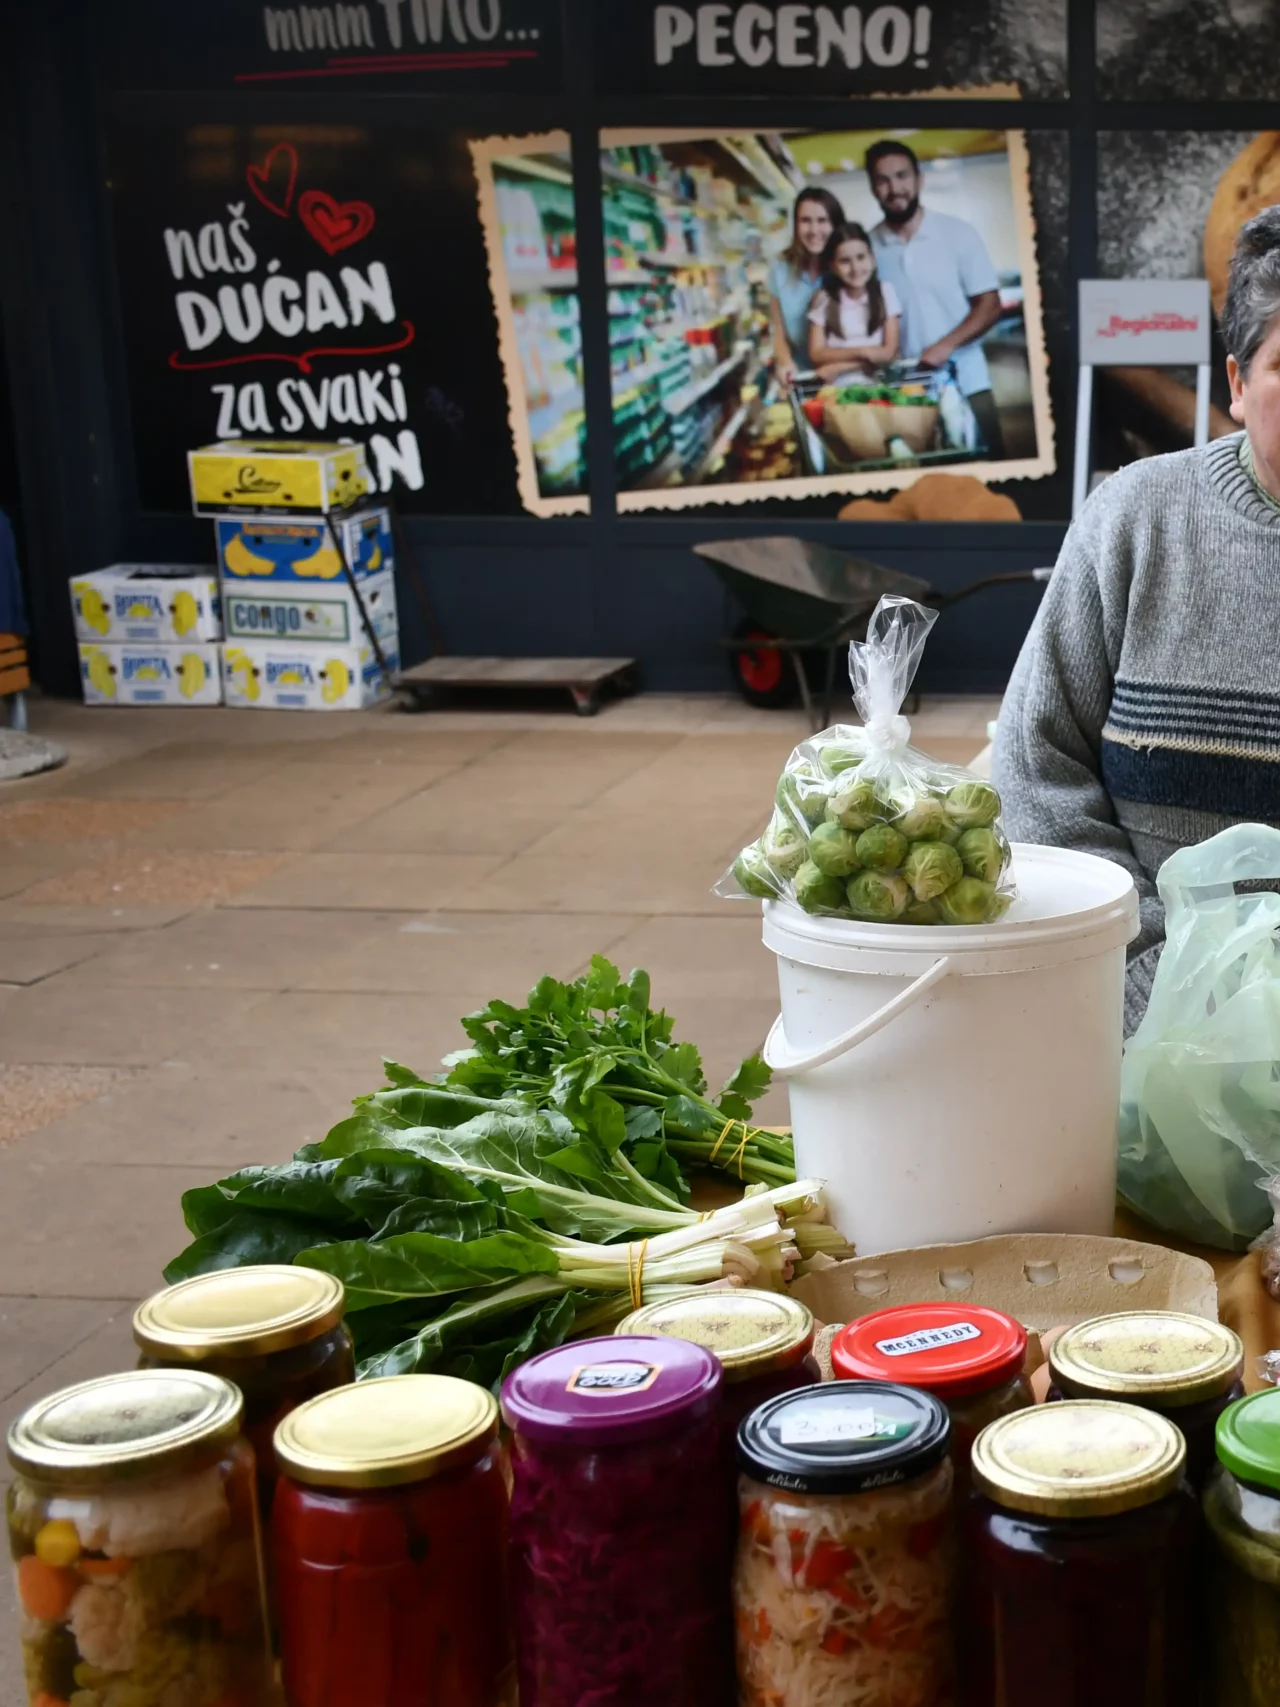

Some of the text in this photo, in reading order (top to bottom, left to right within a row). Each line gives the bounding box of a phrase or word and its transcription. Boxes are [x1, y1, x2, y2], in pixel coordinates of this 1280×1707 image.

[264, 3, 374, 51] mmm
[163, 201, 257, 280] naš
[175, 258, 396, 351] DUĆAN
[211, 362, 408, 439] za svaki
